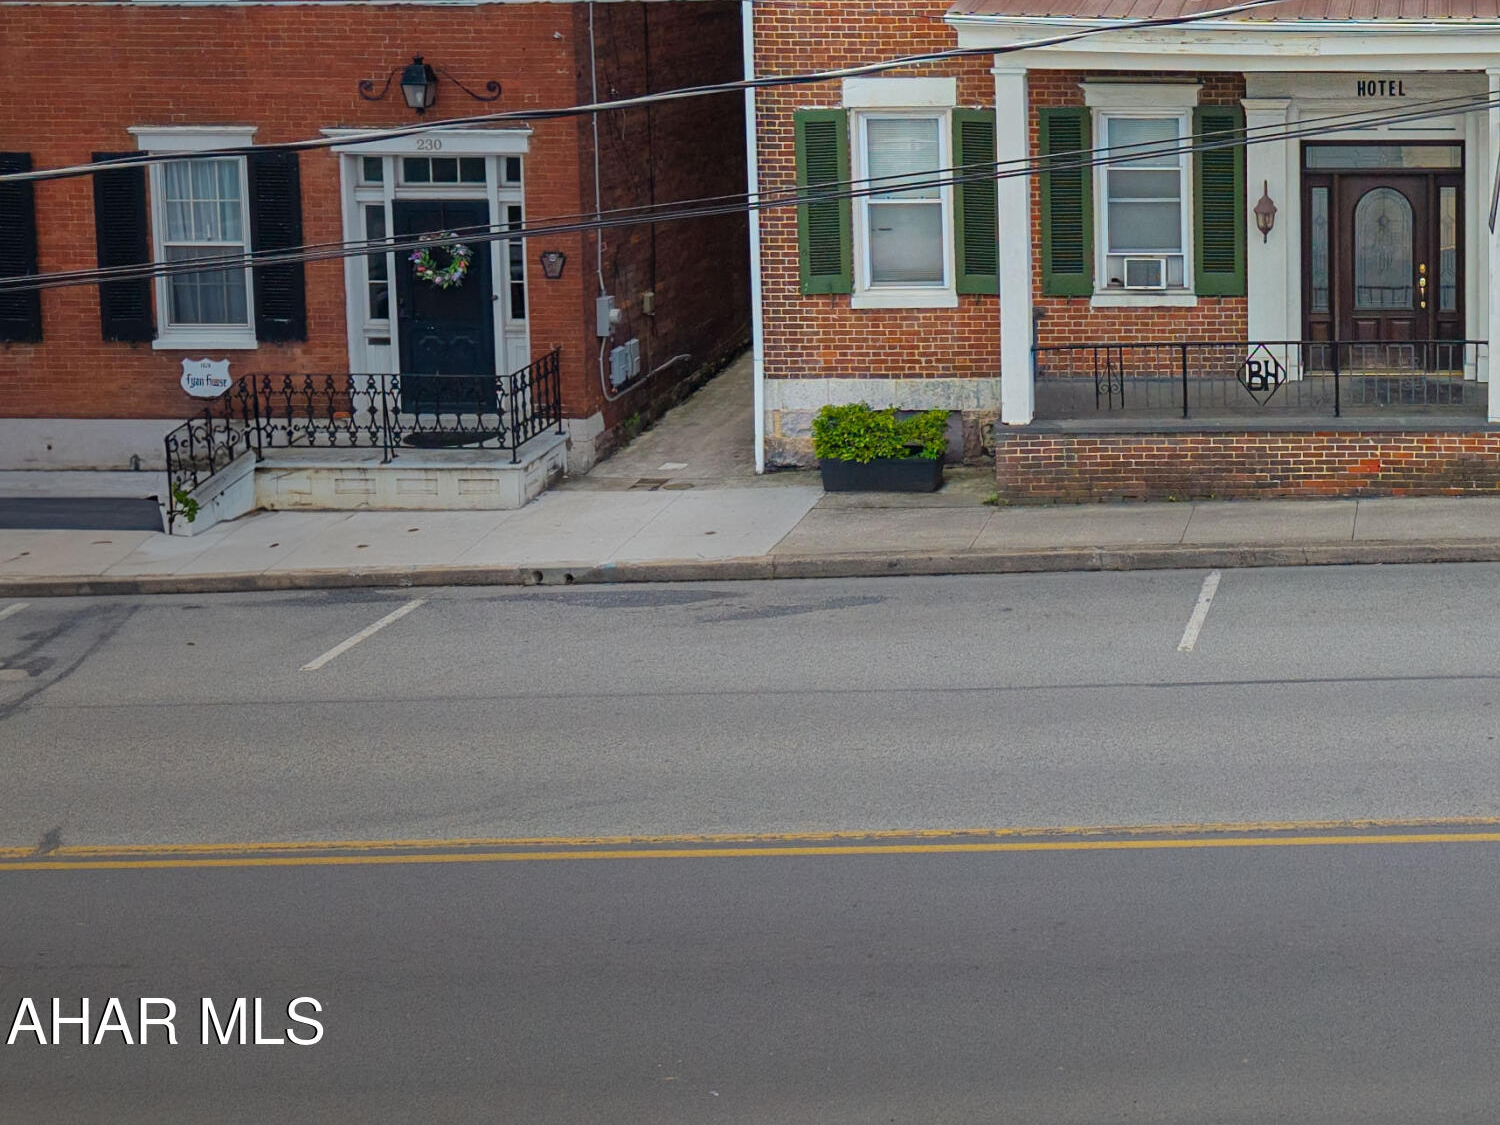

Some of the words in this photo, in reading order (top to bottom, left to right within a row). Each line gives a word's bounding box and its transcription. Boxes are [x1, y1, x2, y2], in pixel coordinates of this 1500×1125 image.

[1357, 80, 1406, 97] HOTEL
[416, 138, 442, 150] 230
[1247, 360, 1279, 391] BH
